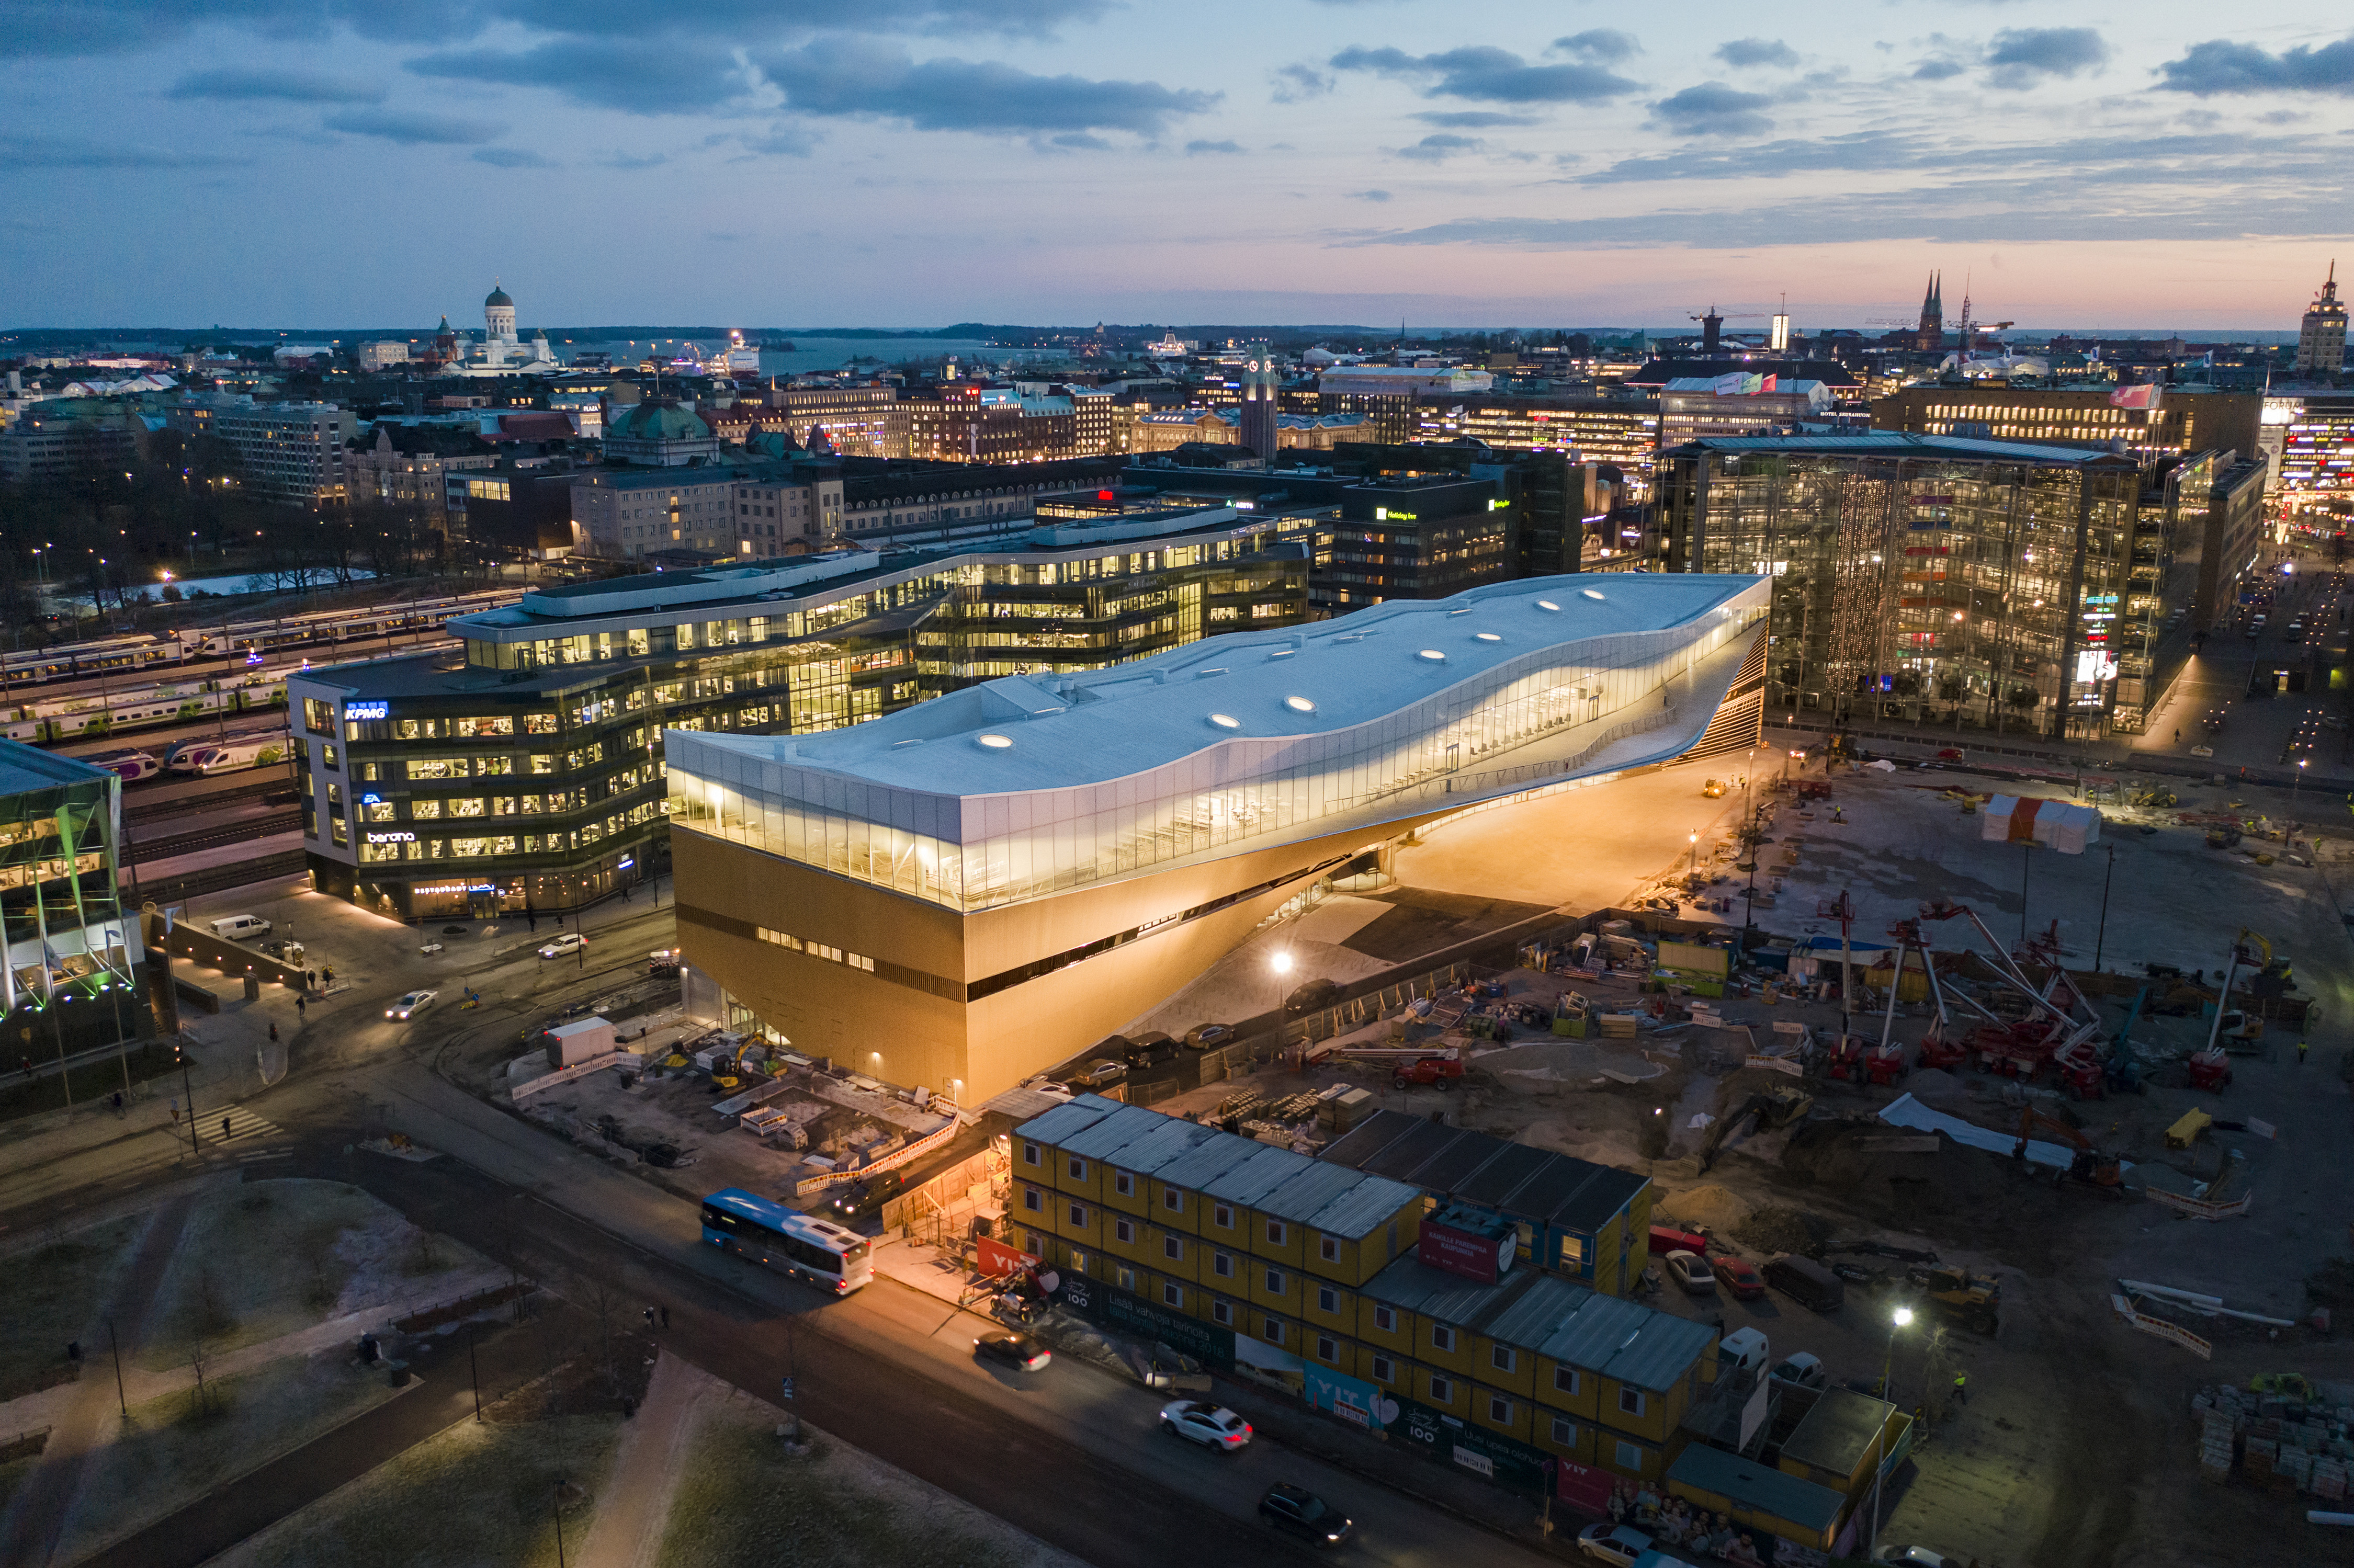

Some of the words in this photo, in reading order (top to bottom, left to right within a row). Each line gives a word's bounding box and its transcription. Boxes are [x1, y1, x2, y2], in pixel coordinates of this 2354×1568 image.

[2264, 401, 2302, 410] FORUM
[1388, 511, 1408, 520] Holiday
[345, 708, 386, 720] KPMG
[364, 794, 381, 803] EA
[367, 832, 415, 843] barona
[1429, 1231, 1454, 1243] KAIKILLE
[1455, 1239, 1487, 1254] PAREMPAA
[1441, 1242, 1474, 1257] KAUPUNKIA
[1068, 1293, 1088, 1307] 100
[1109, 1293, 1133, 1311] Lisää
[1135, 1305, 1170, 1326] vahvoja
[1173, 1319, 1209, 1342] tarinoita
[1198, 1340, 1225, 1358] 2018
[1317, 1378, 1359, 1405] YIT
[1410, 1426, 1434, 1443] 100
[1464, 1429, 1485, 1444] Uusi
[1487, 1439, 1509, 1455] upea
[1563, 1461, 1588, 1476] YIT
